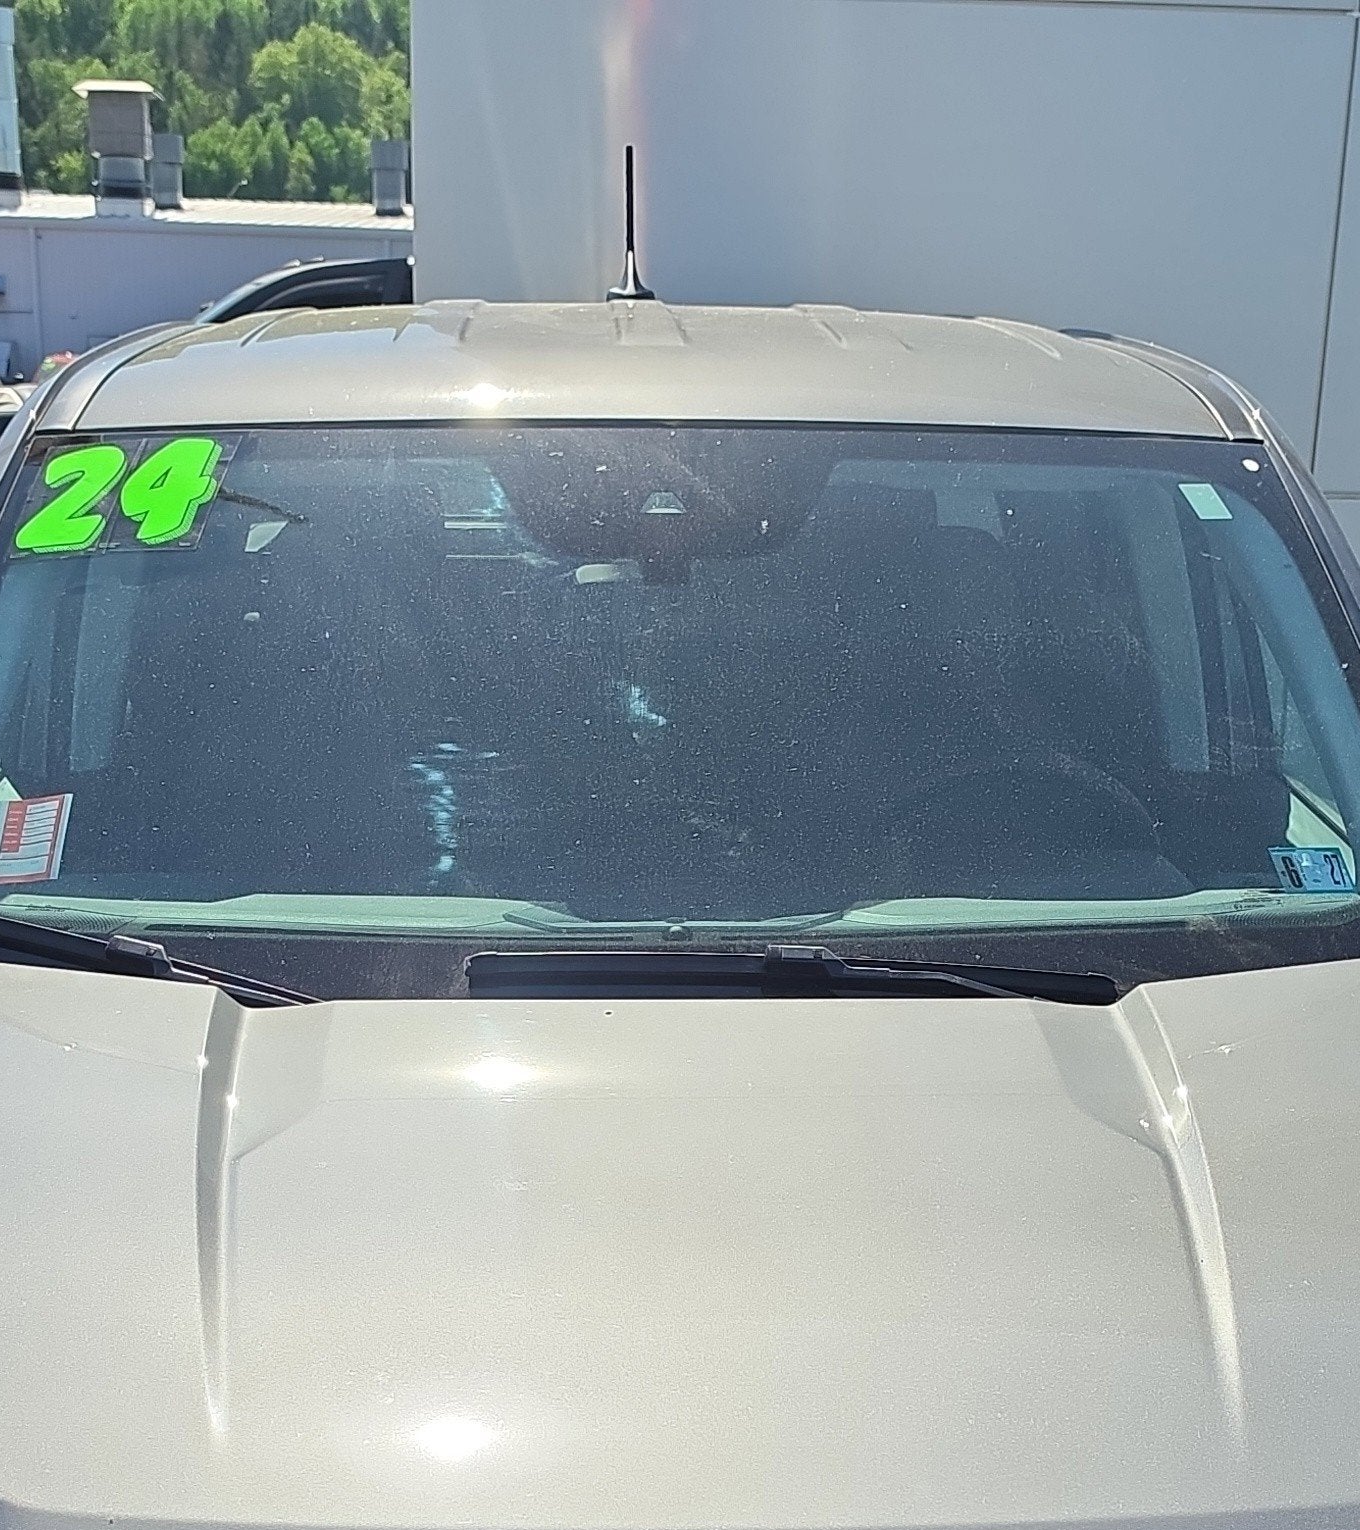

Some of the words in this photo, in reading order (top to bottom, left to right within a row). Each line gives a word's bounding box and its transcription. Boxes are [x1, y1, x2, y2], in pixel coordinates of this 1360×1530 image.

[15, 438, 224, 554] 24
[1281, 855, 1304, 888] 6
[1322, 853, 1347, 888] 27
